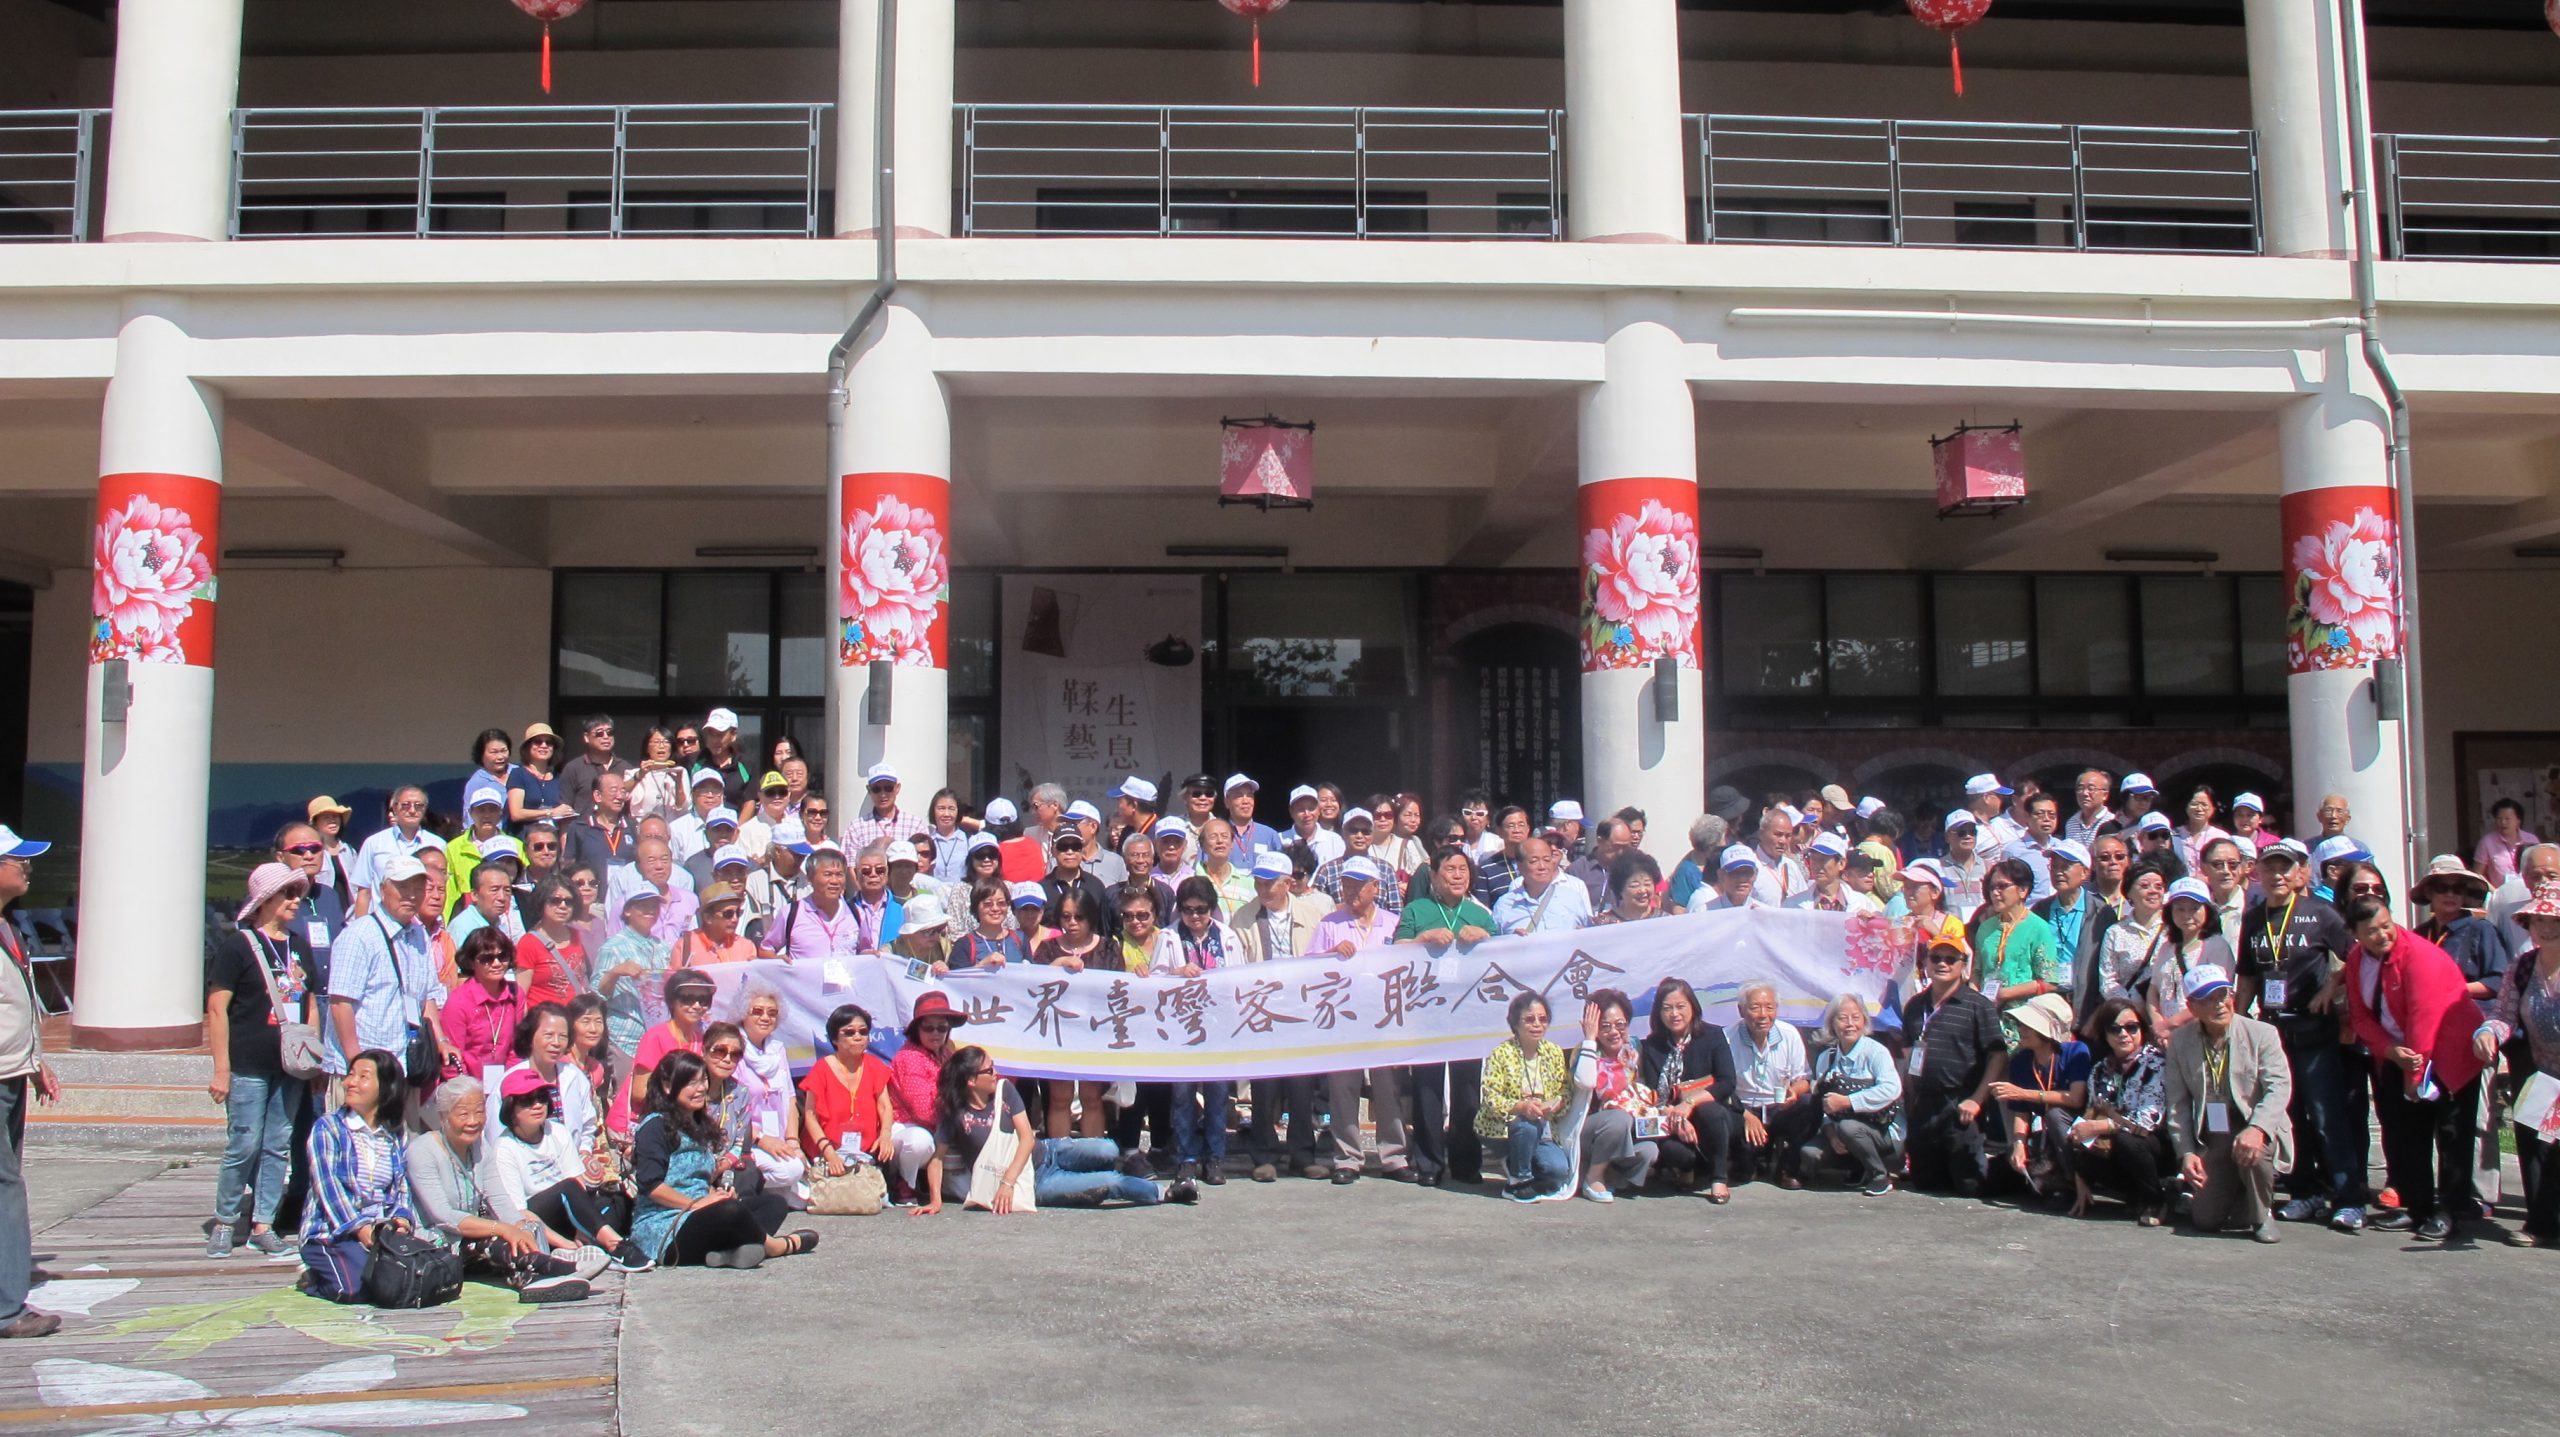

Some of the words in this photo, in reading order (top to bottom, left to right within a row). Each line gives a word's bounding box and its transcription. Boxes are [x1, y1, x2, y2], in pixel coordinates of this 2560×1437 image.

[1103, 693, 1140, 771] 生息
[2294, 915, 2318, 924] THAA
[961, 948, 1626, 1050] 世界臺灣客家聯合會
